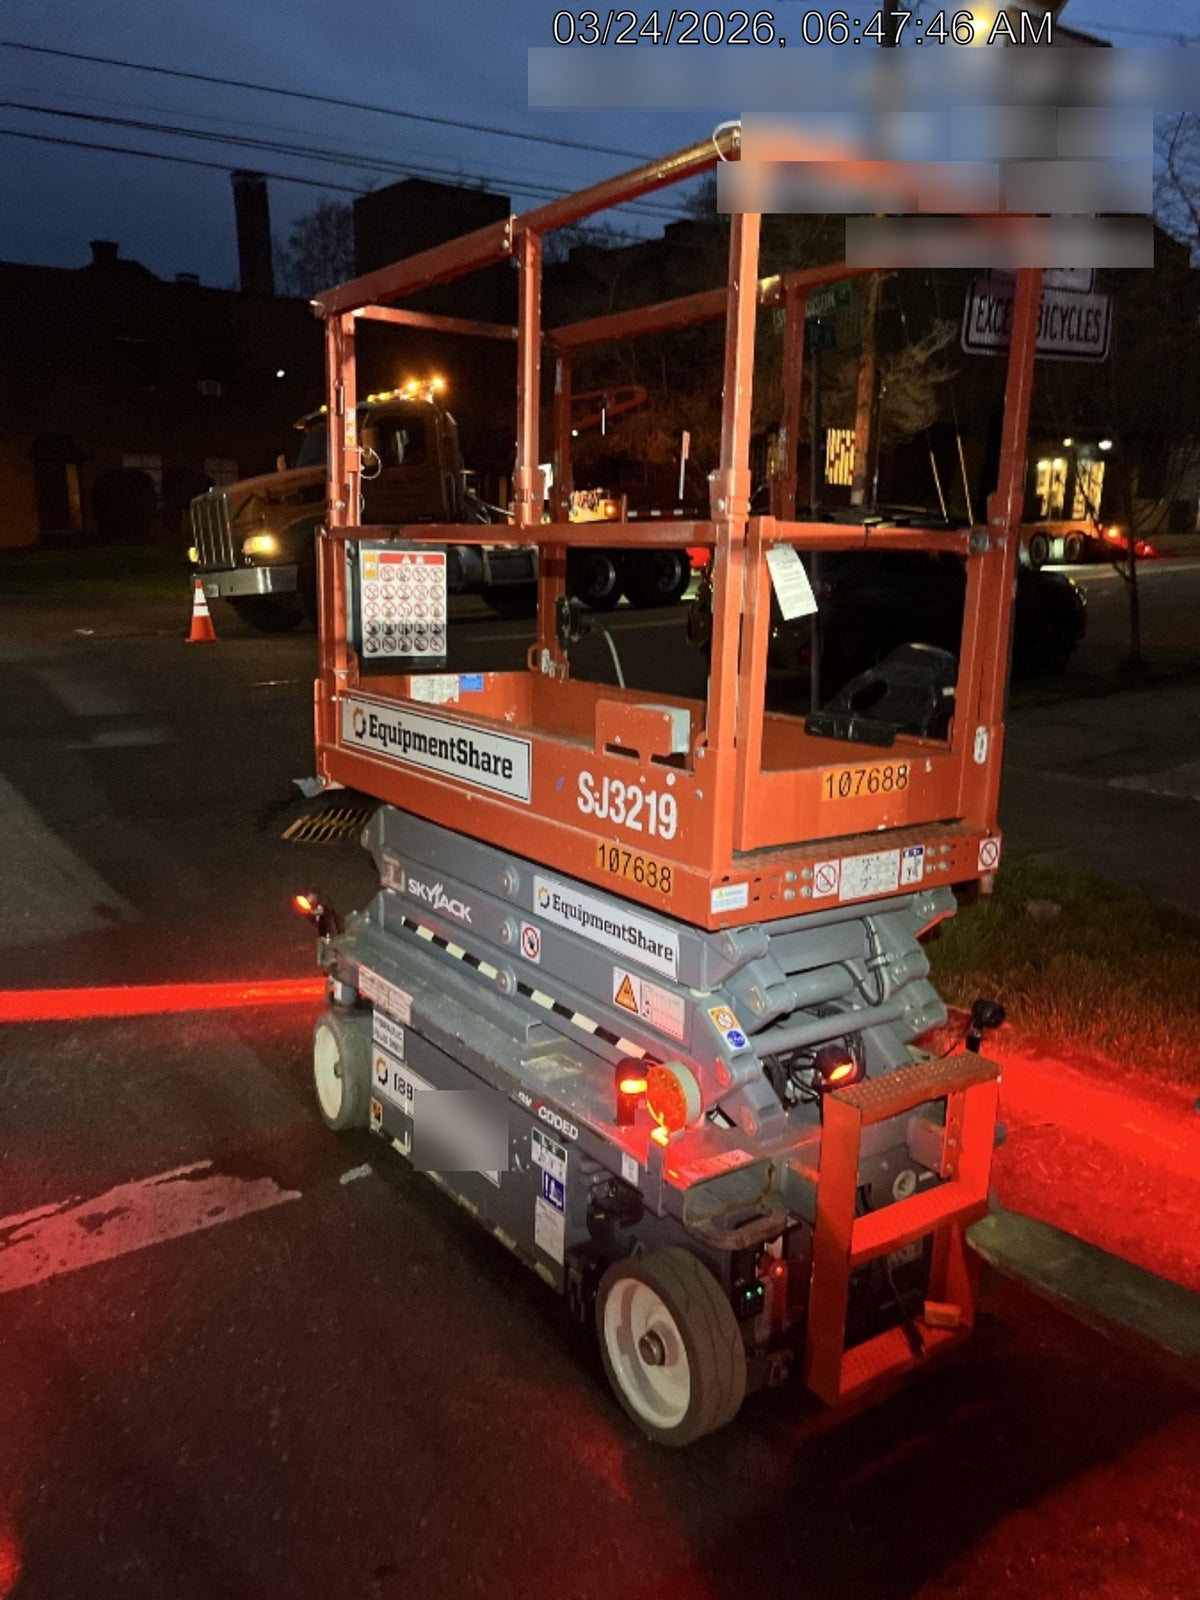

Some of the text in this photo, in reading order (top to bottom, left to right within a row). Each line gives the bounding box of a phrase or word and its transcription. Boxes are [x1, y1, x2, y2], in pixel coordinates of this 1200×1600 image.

[976, 296, 1012, 335] EXCE
[369, 714, 513, 780] EquipmentShare
[577, 770, 678, 840] SJ3219
[825, 764, 909, 798] 107688
[598, 843, 672, 894] 107688
[408, 878, 473, 922] SKYJACK
[552, 893, 675, 962] EquipmentShare
